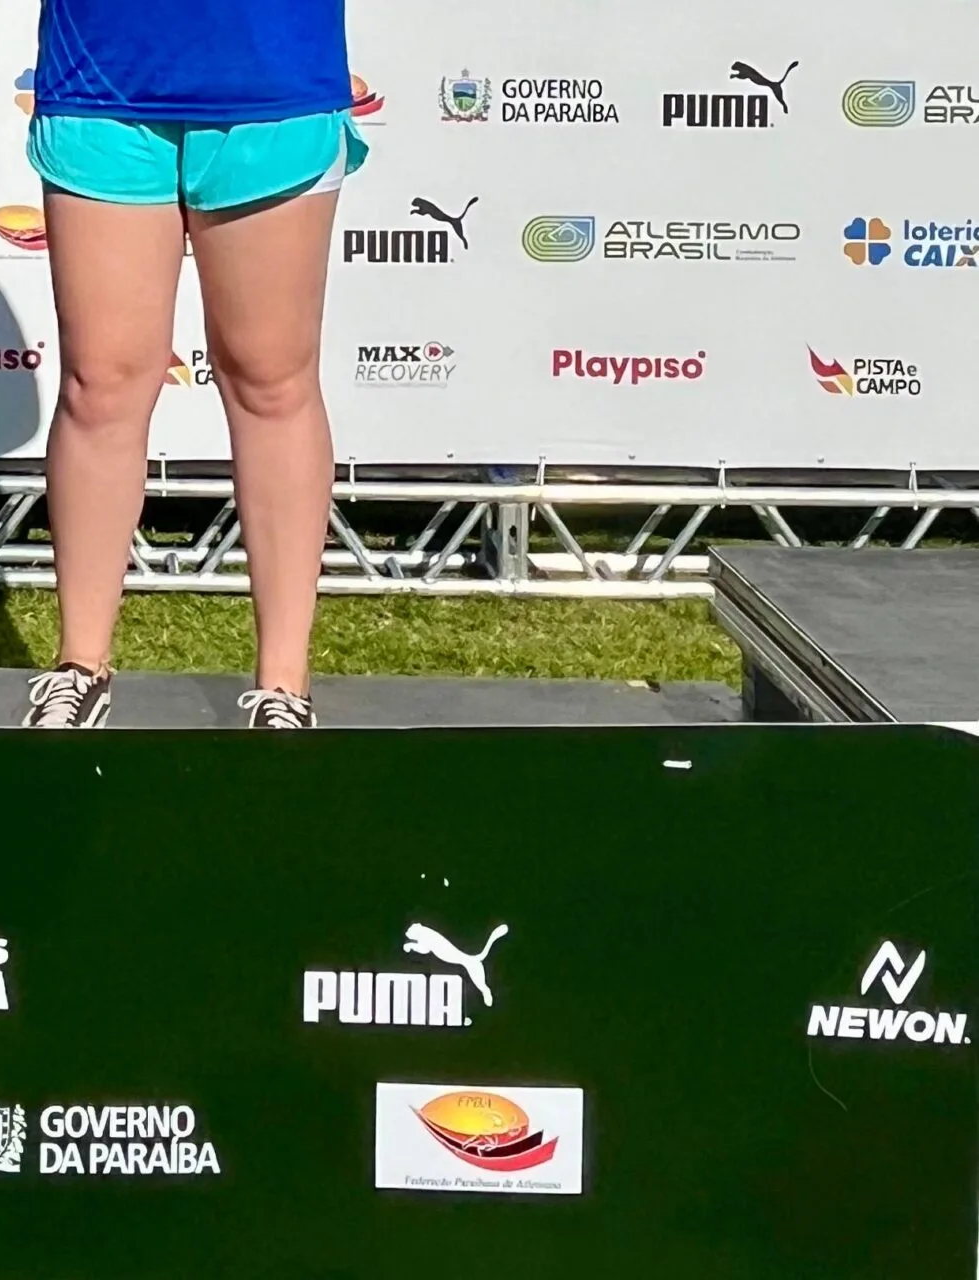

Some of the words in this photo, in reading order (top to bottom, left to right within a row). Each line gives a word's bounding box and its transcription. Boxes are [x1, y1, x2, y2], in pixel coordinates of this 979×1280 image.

[502, 79, 602, 102] GOVERNO
[502, 103, 529, 122] DA
[663, 94, 768, 127] PUMA
[924, 106, 979, 123] BR
[605, 222, 800, 240] ATLETISMO
[344, 230, 448, 263] PUMA
[604, 242, 731, 260] BRASIL
[358, 347, 421, 362] MAX
[356, 364, 456, 380] RECOVERY
[553, 349, 703, 385] Playpiso
[854, 359, 904, 375] PISTA
[907, 364, 917, 376] e
[857, 378, 920, 395] CAMPO
[304, 971, 463, 1026] PUMA
[40, 1105, 195, 1138] GOVERNO
[40, 1142, 85, 1173] DA
